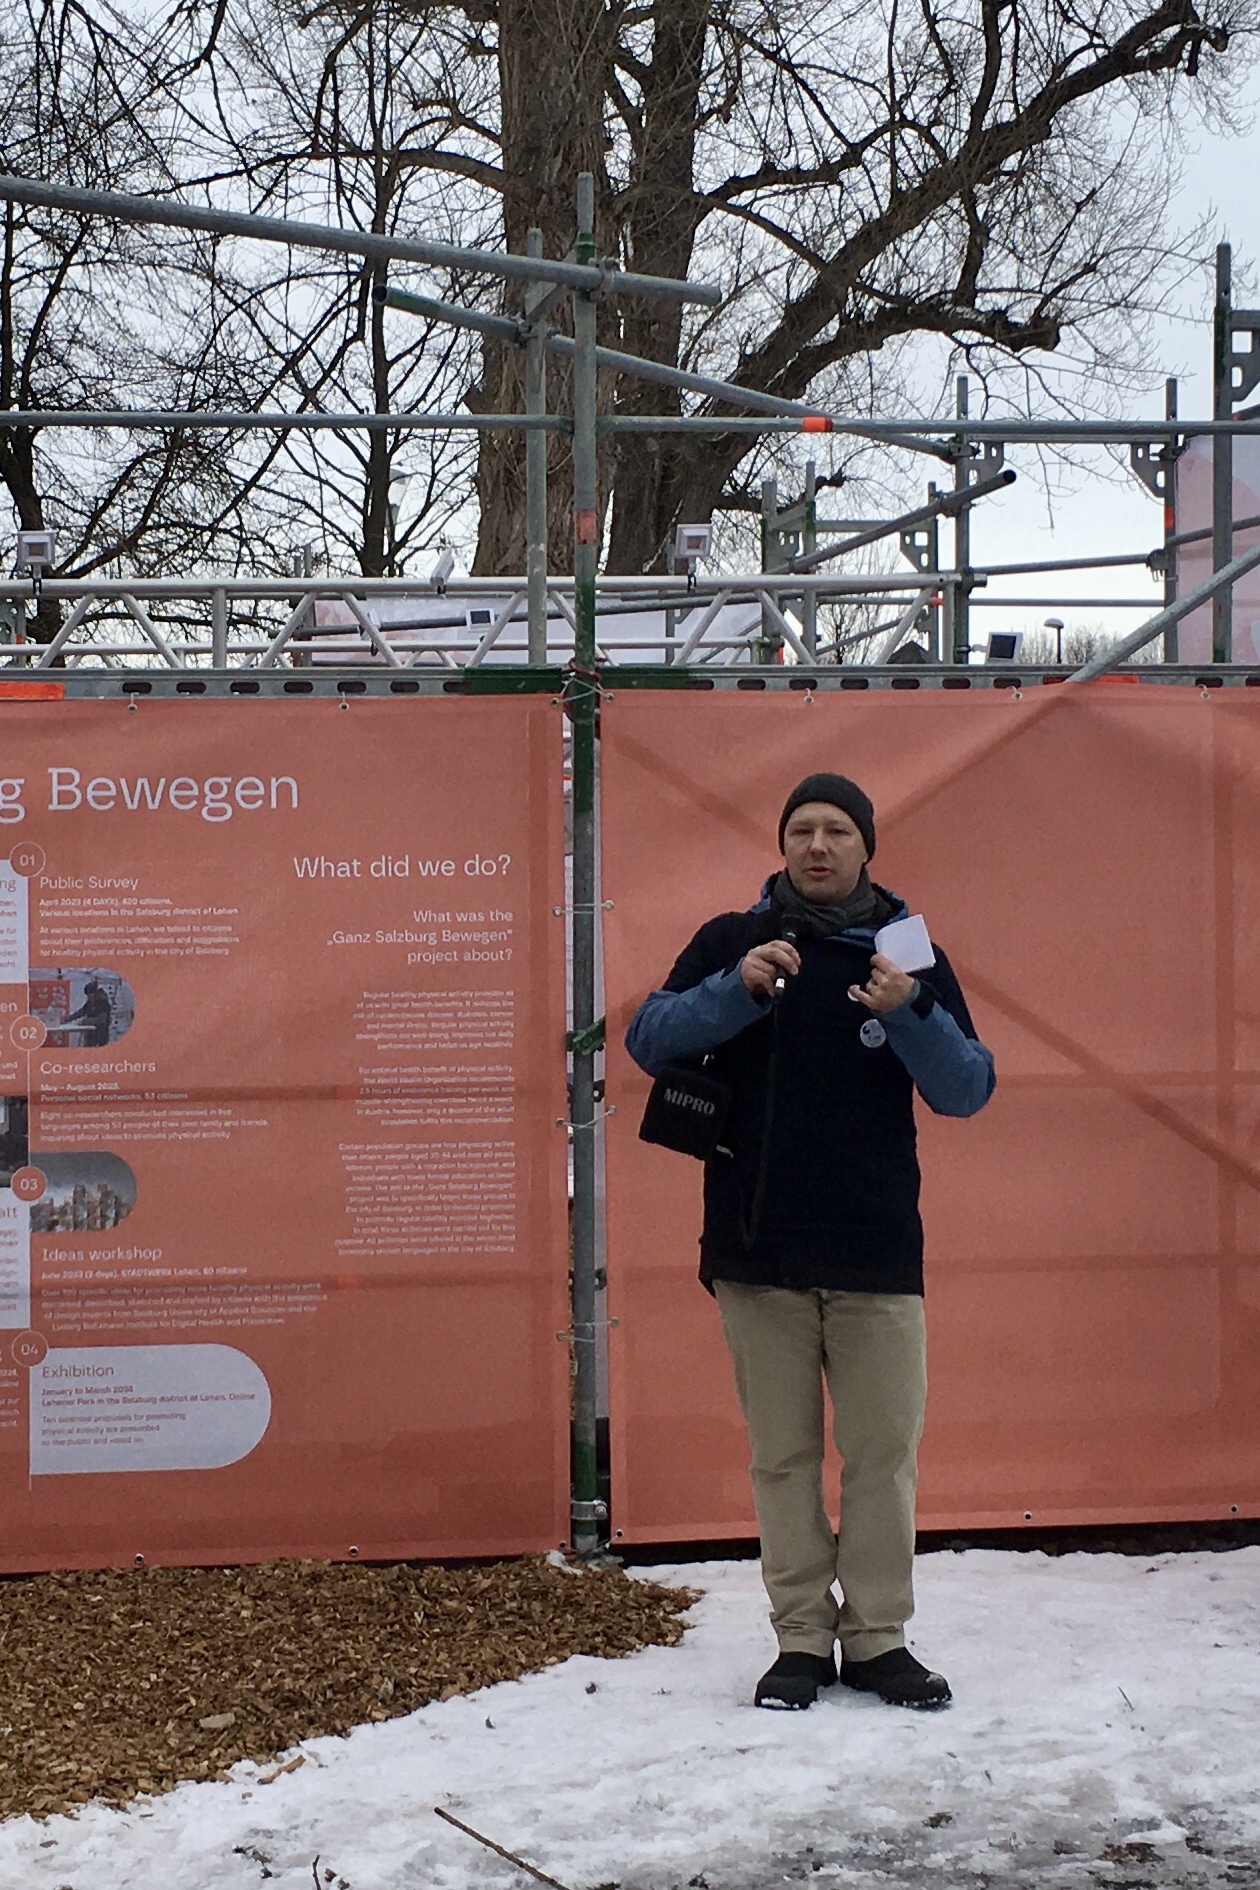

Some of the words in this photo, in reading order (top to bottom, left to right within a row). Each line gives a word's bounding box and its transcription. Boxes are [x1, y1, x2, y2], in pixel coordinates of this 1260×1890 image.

[47, 767, 299, 823] Bewegen
[19, 854, 36, 867] 01
[293, 856, 361, 879] What
[369, 855, 411, 878] did
[417, 861, 456, 878] we
[463, 854, 512, 877] do?
[39, 876, 84, 890] Public
[88, 876, 139, 891] Survey
[412, 908, 448, 923] What
[453, 911, 484, 922] was
[488, 908, 513, 922] the
[375, 928, 438, 947] Salzburg
[407, 947, 458, 965] project
[463, 946, 513, 962] about?
[19, 1026, 37, 1040] 02
[40, 1060, 156, 1075] Co-researchers
[663, 1087, 715, 1114] MIPRO
[20, 1177, 39, 1191] 03
[42, 1248, 84, 1261] Ideas
[89, 1246, 162, 1263] workshop
[20, 1342, 39, 1357] 04
[42, 1365, 115, 1379] Exhibition
